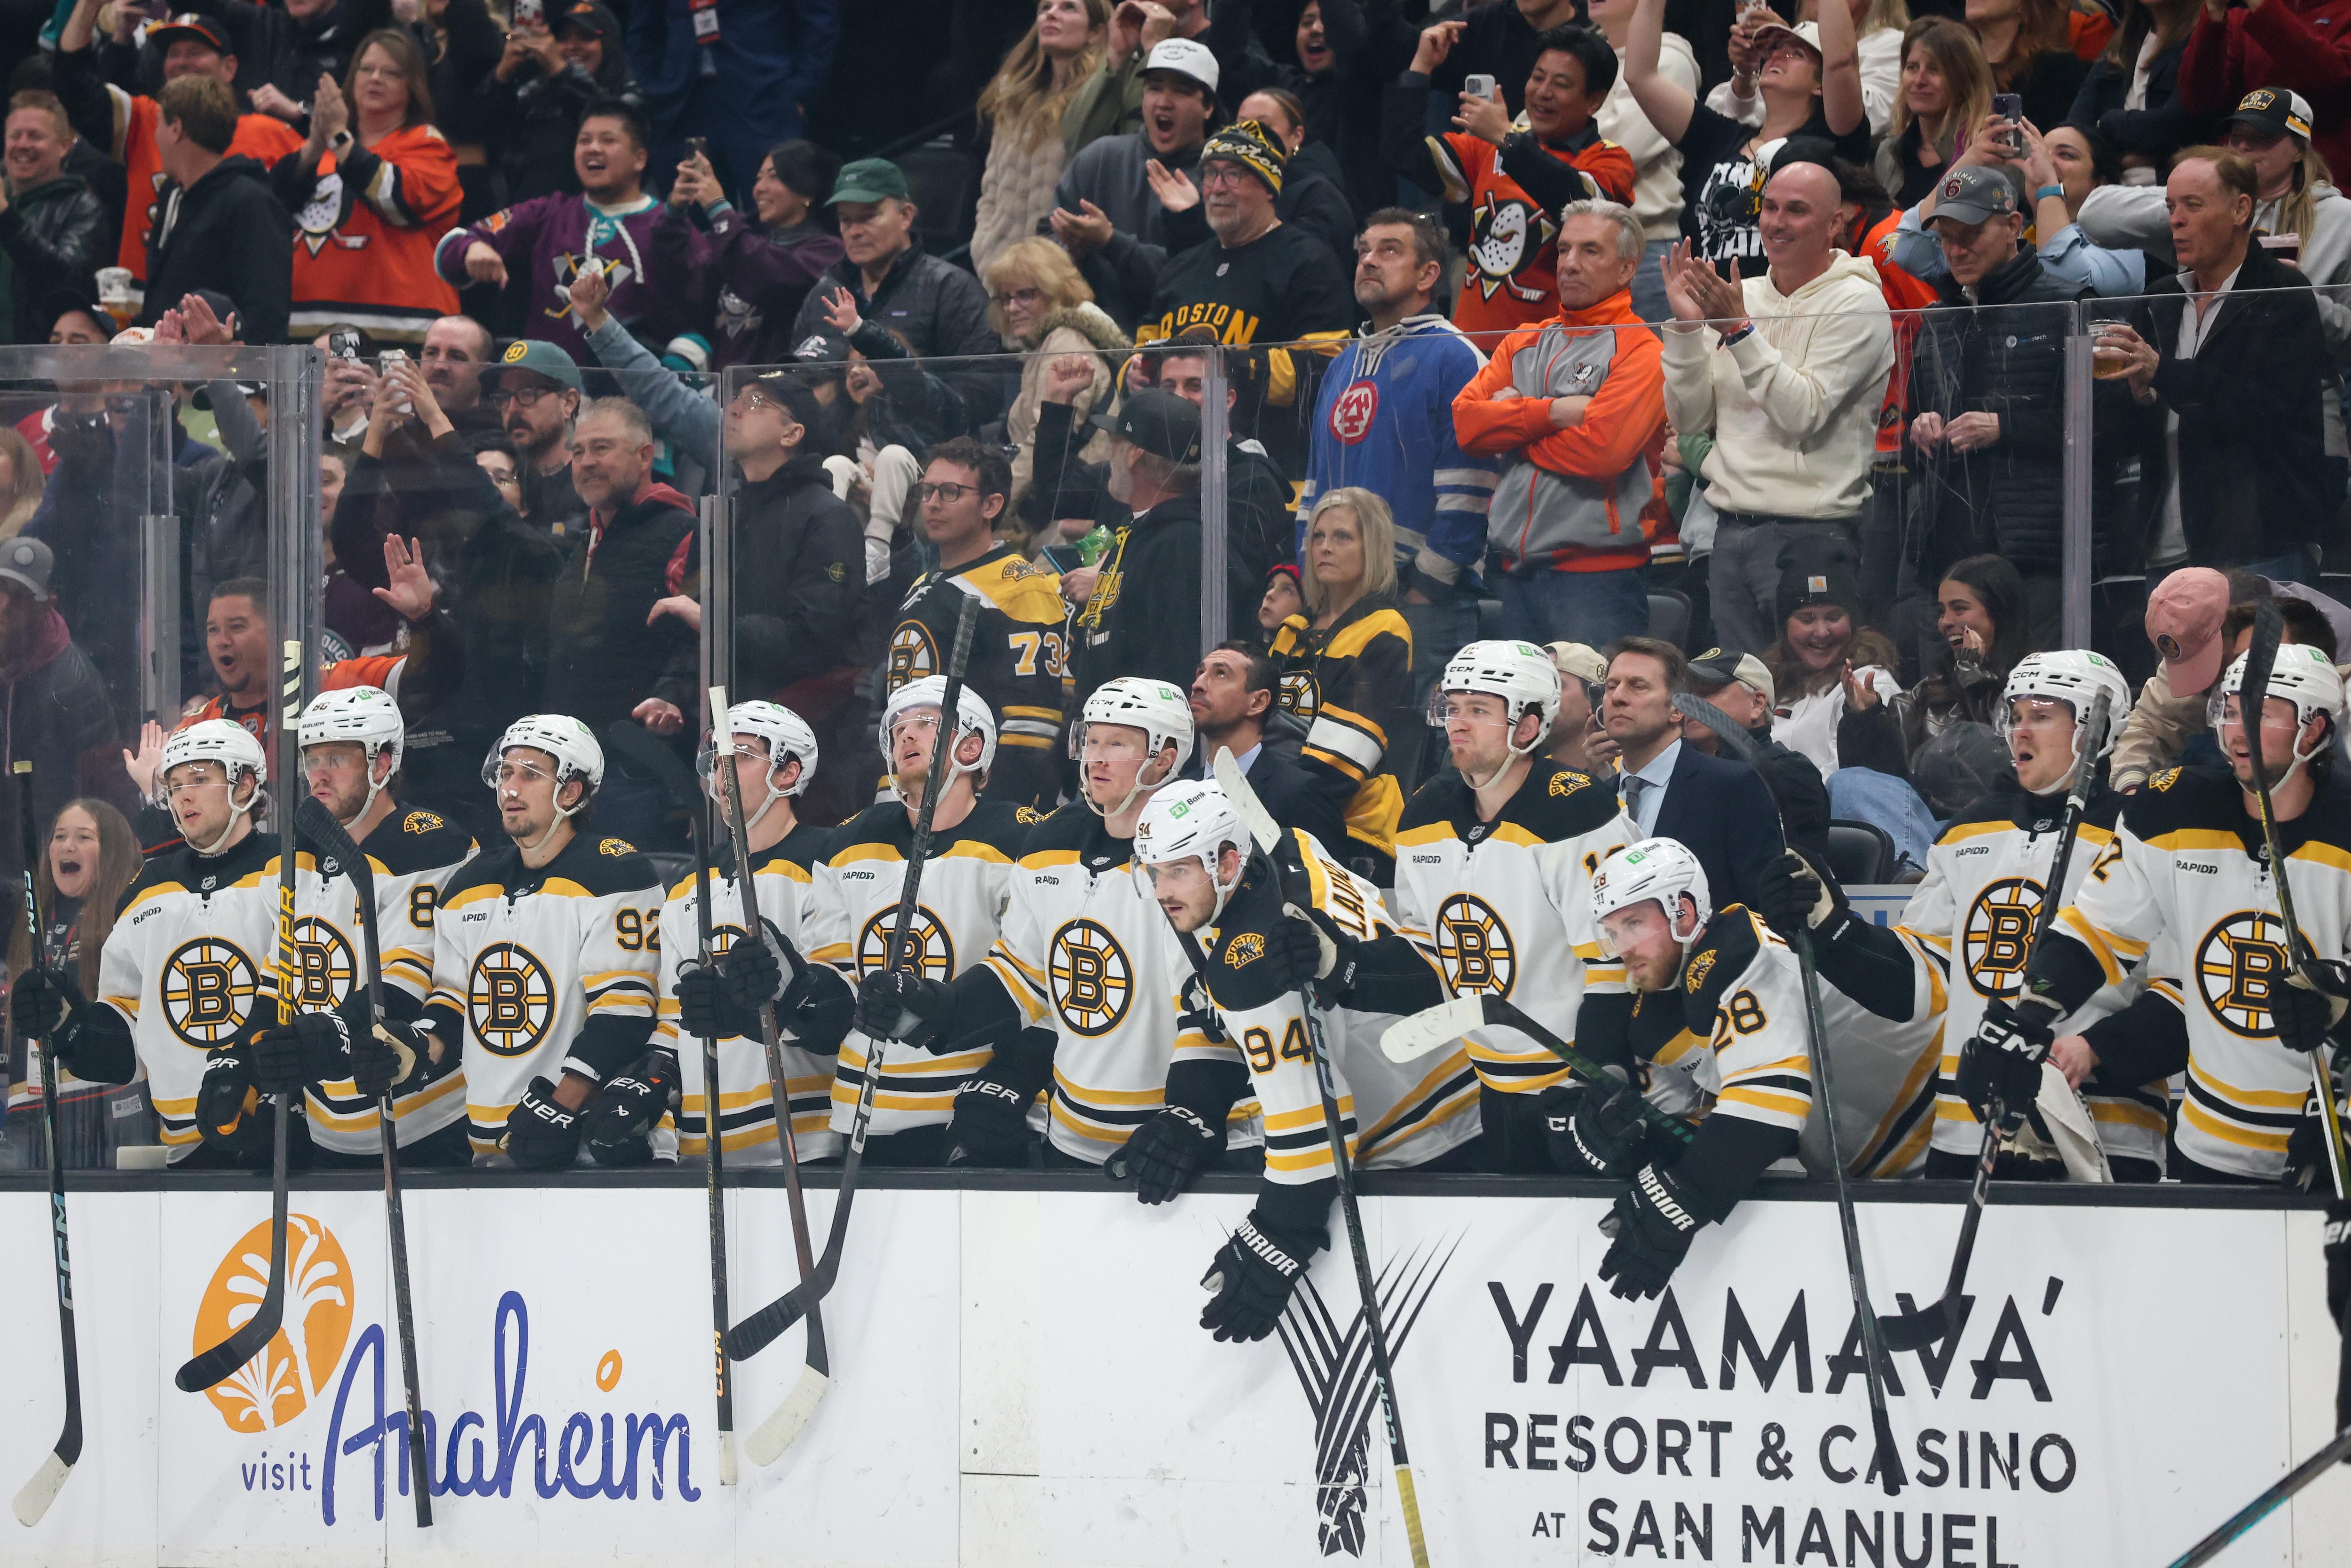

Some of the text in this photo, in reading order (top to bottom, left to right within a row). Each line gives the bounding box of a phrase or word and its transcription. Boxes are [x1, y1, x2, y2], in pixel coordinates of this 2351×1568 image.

[1944, 178, 1962, 199] 6
[1160, 302, 1259, 351] BOSTON
[322, 634, 348, 662] DUC
[1008, 631, 1063, 677] 73
[1517, 645, 1533, 657] TD
[787, 710, 804, 723] Bank
[1157, 687, 1173, 701] TD
[166, 741, 190, 753] CCM
[723, 755, 734, 785] BAUE
[1168, 791, 1206, 819] TD Bank
[1551, 773, 1588, 795] BOSTON
[405, 812, 442, 831] BOSTON
[1137, 822, 1151, 836] 94
[842, 871, 875, 881] RAPID7
[1412, 855, 1442, 864] RAPID7
[1625, 842, 1661, 865] TD Bank
[2175, 860, 2217, 875] RAPID7
[24, 870, 36, 934] CCM
[132, 907, 162, 925] RAPID7
[406, 884, 435, 930] 8
[615, 907, 661, 951] 92
[1226, 935, 1265, 961] BOSTON
[1981, 905, 2032, 971] B
[278, 884, 296, 1026] BAUER
[297, 940, 332, 1004] B
[1346, 961, 1356, 984] CCM
[1450, 920, 1494, 986] B
[2225, 938, 2285, 1010] B
[183, 961, 232, 1025] B
[486, 968, 529, 1032] B
[1067, 944, 1107, 1013] B
[1713, 988, 1767, 1056] 28
[1979, 1021, 2043, 1061] CM
[1243, 1016, 1314, 1075] 94
[850, 1039, 886, 1155] CCM
[956, 1080, 1020, 1105] AUER
[706, 1160, 716, 1246] JETSPEED
[1637, 1163, 1695, 1232] ARRIOR
[55, 1193, 74, 1311] CCM
[1237, 1218, 1299, 1277] ARRIOR
[1487, 1276, 2064, 1402] YAAMAVA'
[241, 1290, 702, 1526] visit Anaheim
[403, 1387, 415, 1432] CM
[1376, 1375, 1398, 1445] CCM
[1484, 1412, 1733, 1478] RESORT
[1756, 1422, 1794, 1481] &
[1531, 1497, 2019, 1568] AT SAN MANUEL
